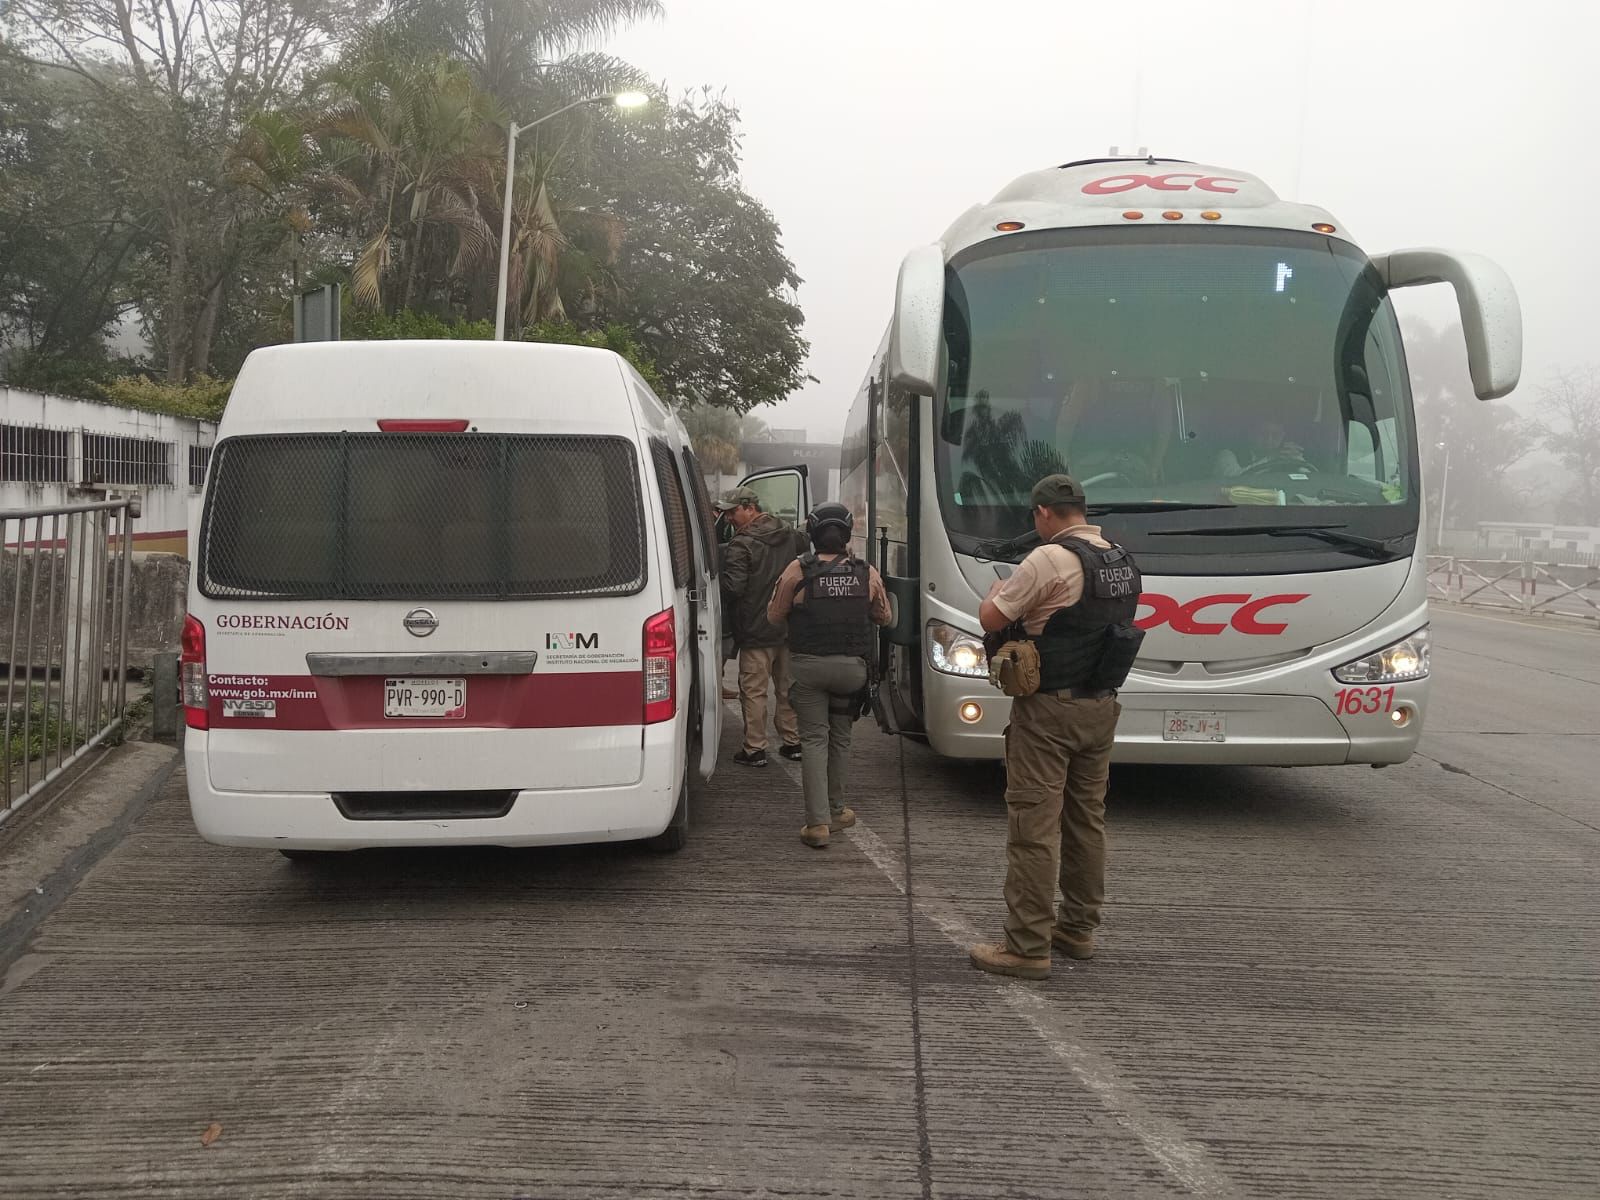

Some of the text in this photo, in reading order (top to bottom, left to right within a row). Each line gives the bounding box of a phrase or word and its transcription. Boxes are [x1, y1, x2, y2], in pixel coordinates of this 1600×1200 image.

[1081, 173, 1246, 195] OCC
[819, 576, 860, 587] FUERZA
[1099, 566, 1135, 583] FUERZA
[828, 586, 854, 596] CIVIL
[1110, 581, 1133, 597] CIVIL
[216, 612, 350, 630] GOBERNACIÓN
[208, 674, 269, 686] Contacto:
[209, 688, 317, 700] www.gob.mx/inm
[387, 688, 463, 707] PVR-990-D
[1334, 686, 1395, 716] 1631
[223, 700, 275, 711] NV350
